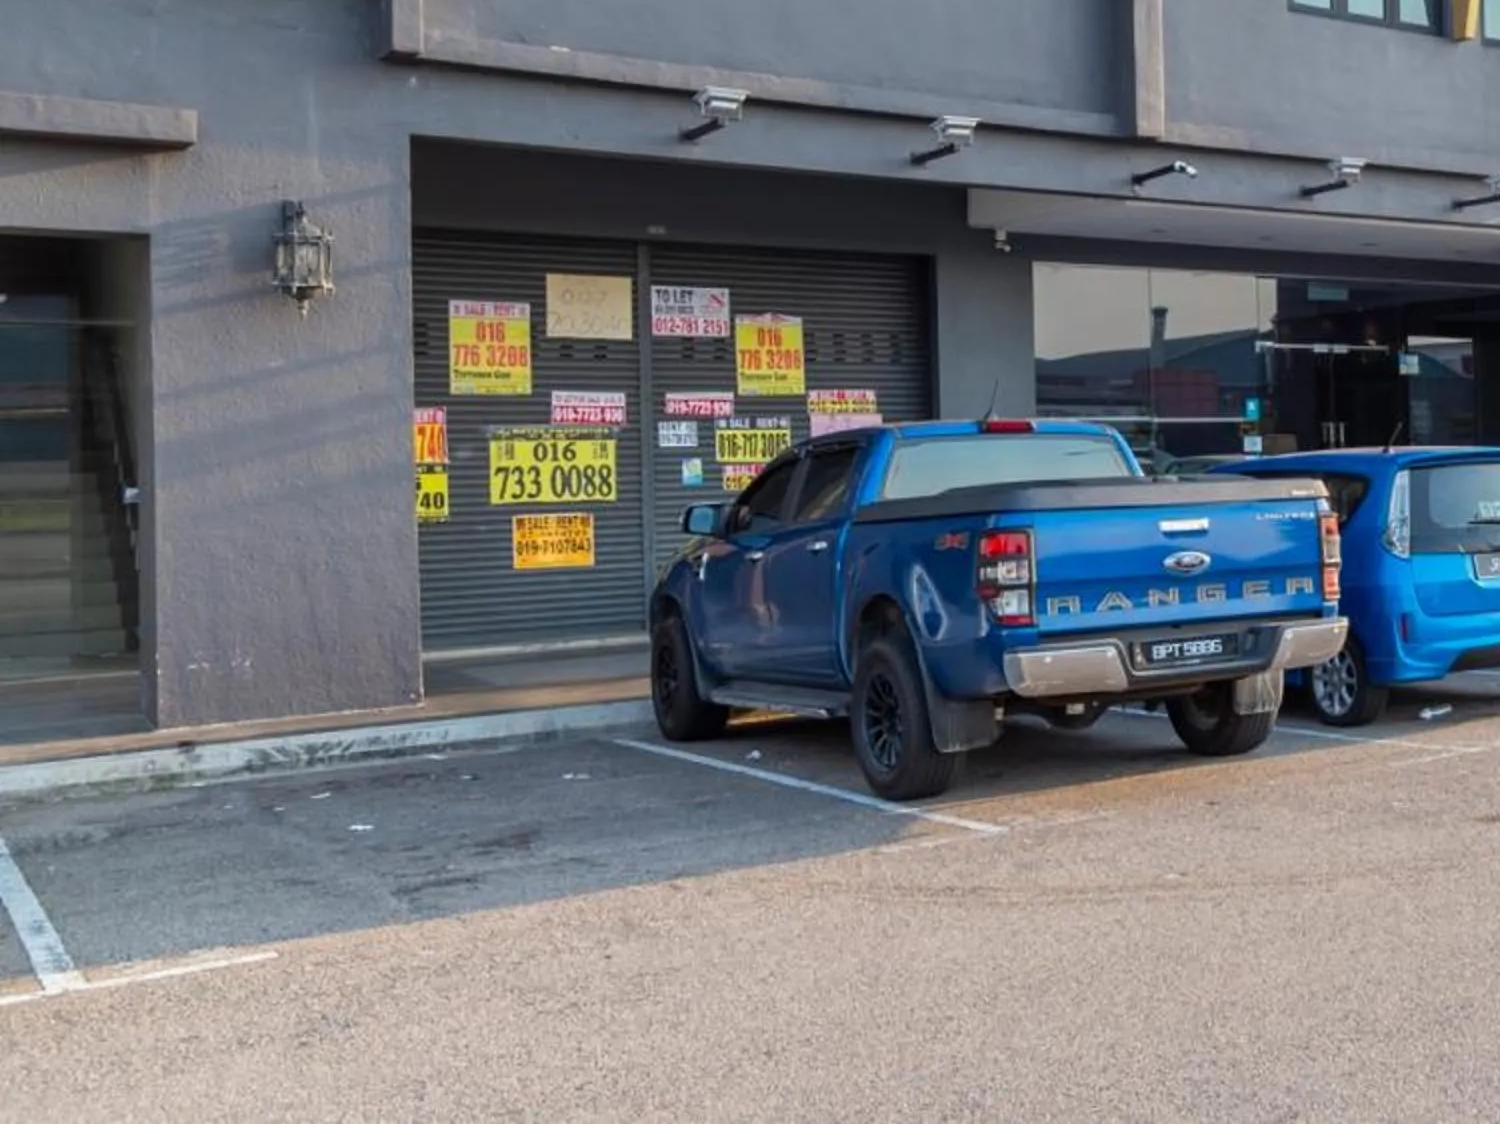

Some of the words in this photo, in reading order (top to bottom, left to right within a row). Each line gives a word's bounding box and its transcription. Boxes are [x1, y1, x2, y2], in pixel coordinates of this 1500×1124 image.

[655, 289, 671, 303] TO
[673, 289, 694, 304] LET
[475, 321, 506, 343] 016
[757, 327, 783, 348] 016
[533, 441, 577, 463] 016
[494, 465, 542, 500] 733
[551, 464, 613, 499] 0088
[1046, 576, 1315, 617] RANGER
